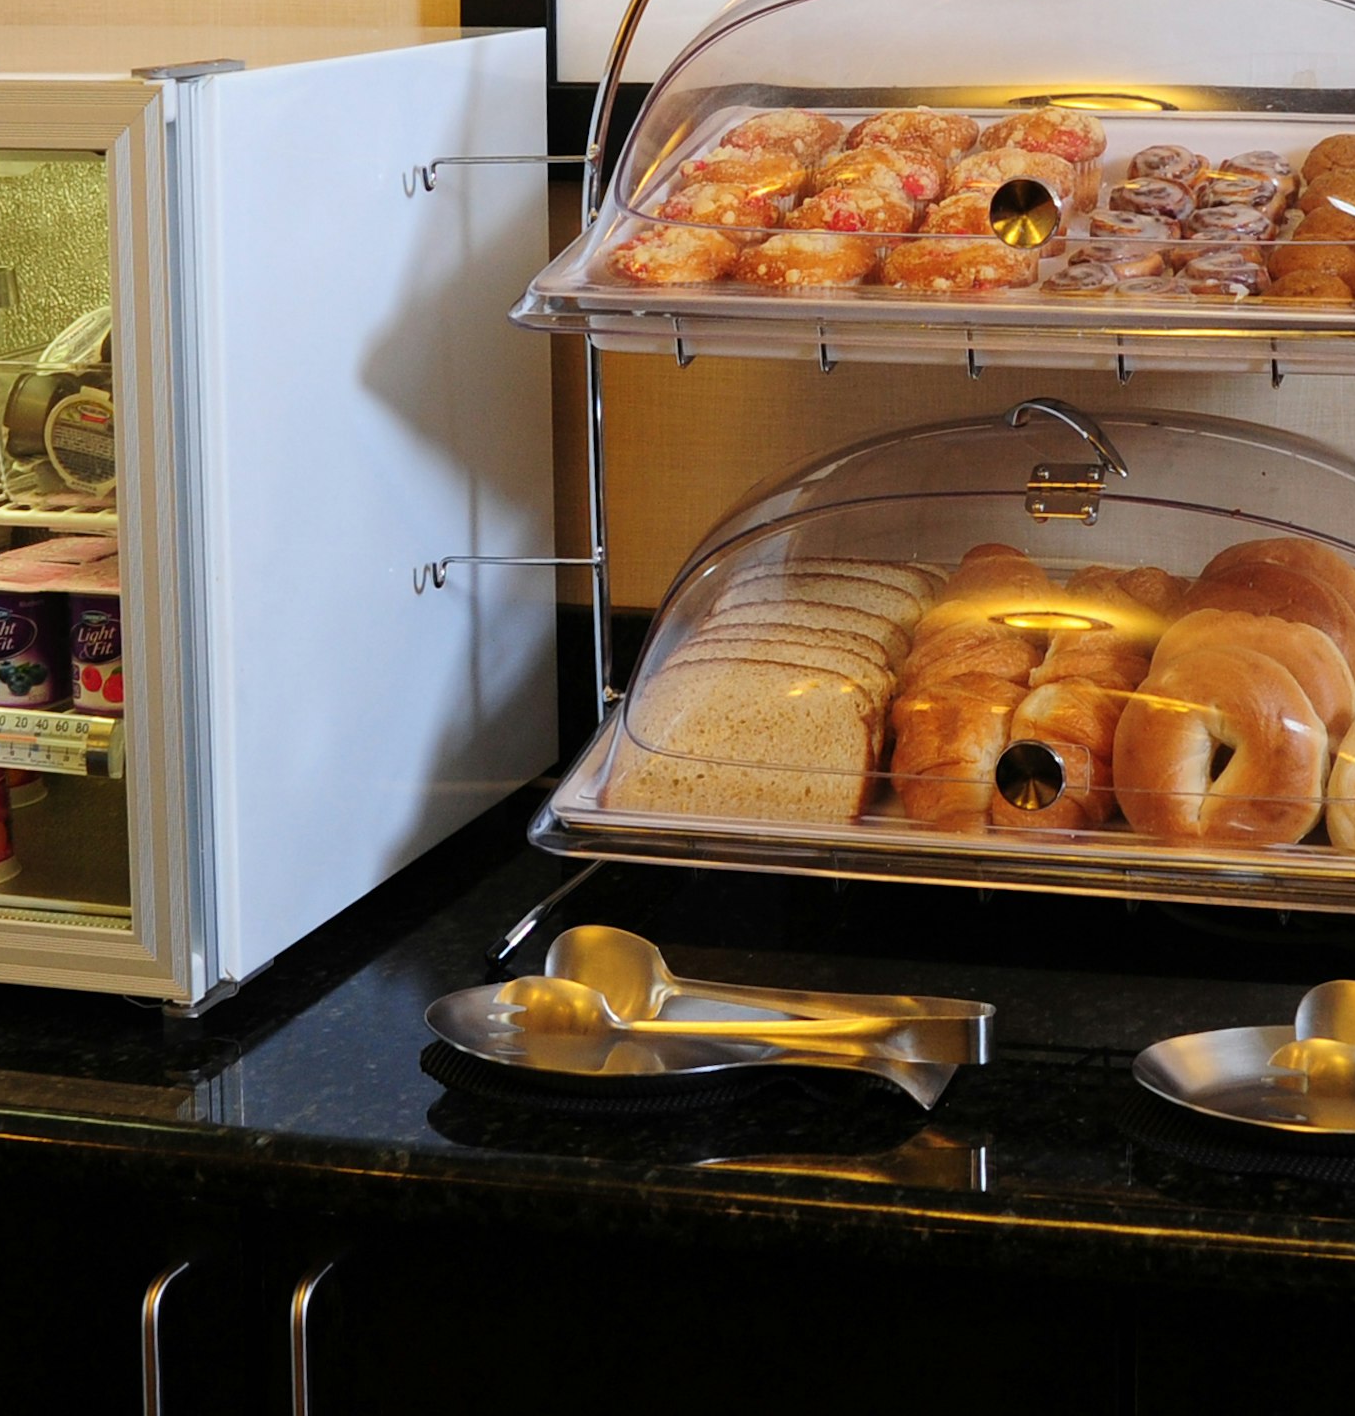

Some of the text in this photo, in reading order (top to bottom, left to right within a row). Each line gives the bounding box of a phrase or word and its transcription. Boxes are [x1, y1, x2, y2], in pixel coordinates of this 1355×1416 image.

[77, 625, 116, 646] Light
[0, 715, 6, 726] 0
[15, 716, 28, 728] 20
[36, 719, 49, 730] 40
[55, 720, 69, 732] 60
[75, 722, 90, 734] 80
